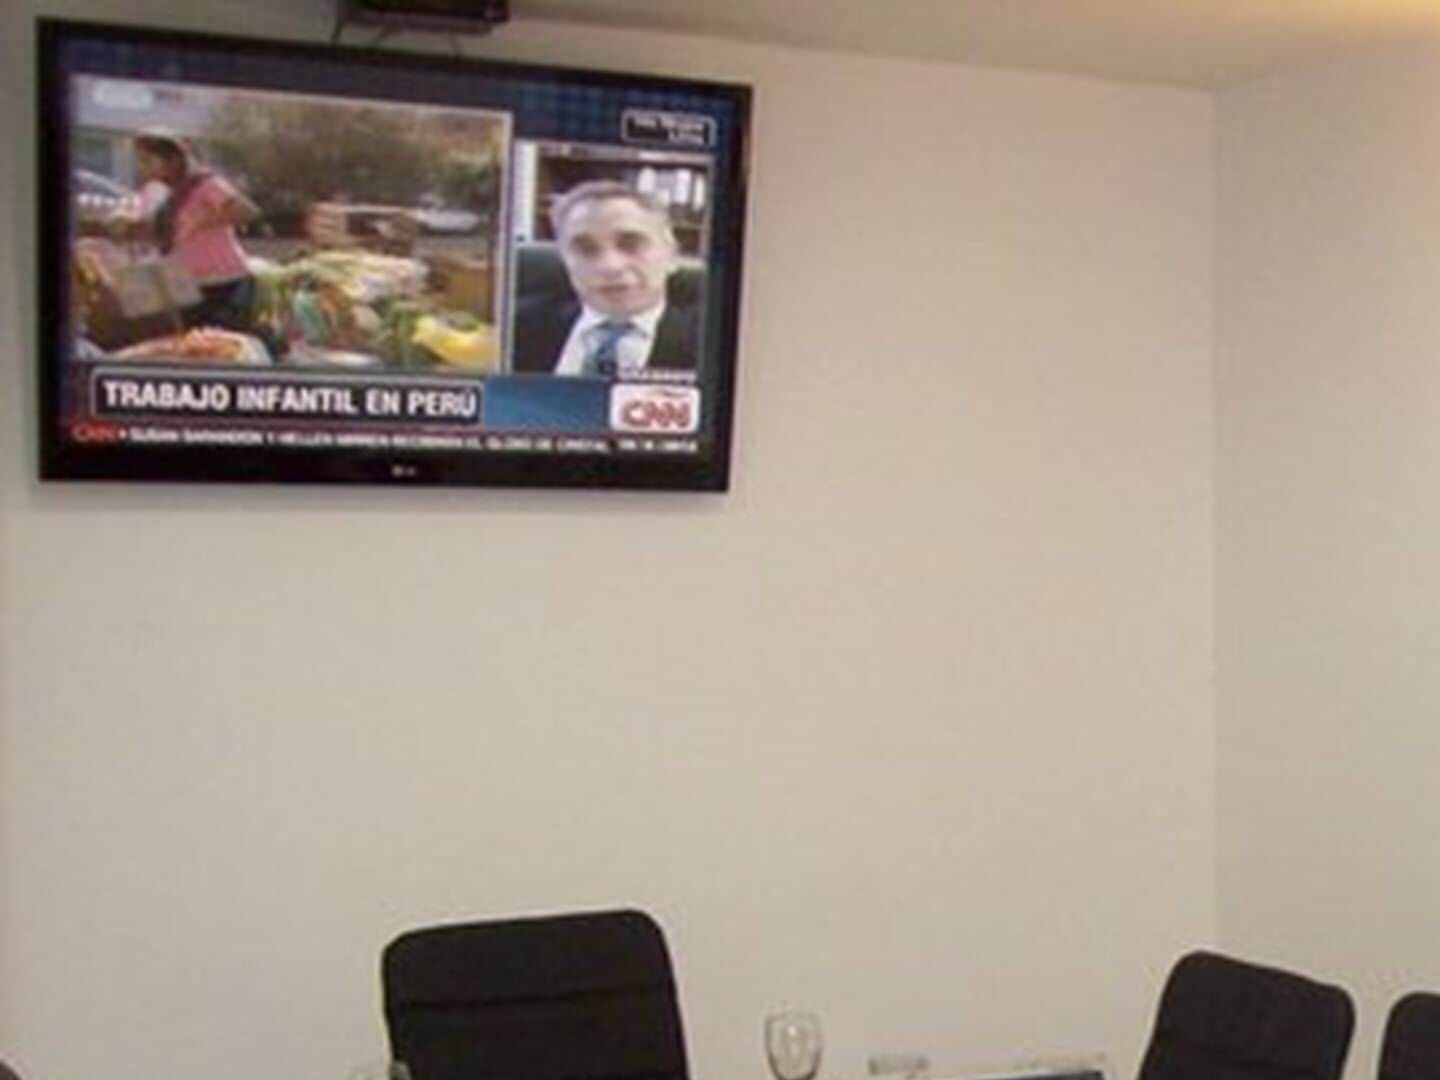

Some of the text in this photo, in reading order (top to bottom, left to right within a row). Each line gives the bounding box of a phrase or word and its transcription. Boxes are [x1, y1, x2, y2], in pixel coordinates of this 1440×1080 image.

[103, 380, 477, 417] TRABAJO INFANTIL EN PERÚ
[620, 401, 691, 428] CNN
